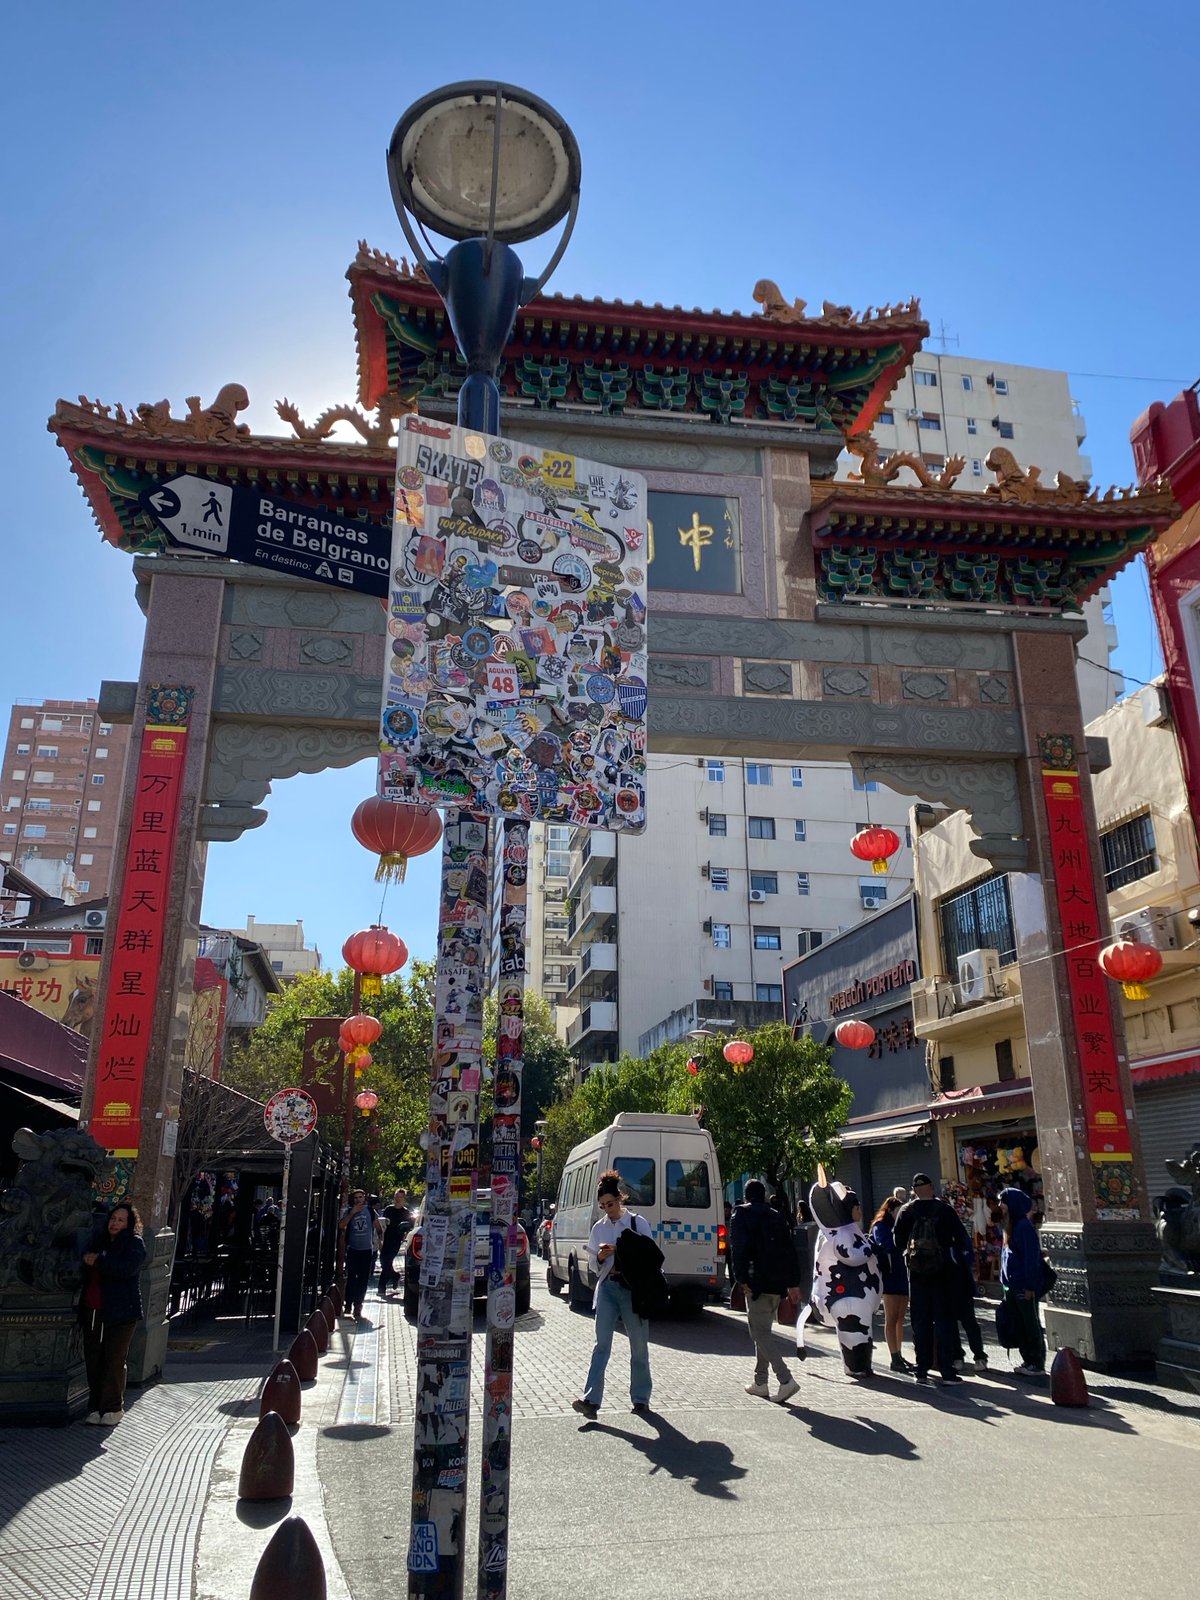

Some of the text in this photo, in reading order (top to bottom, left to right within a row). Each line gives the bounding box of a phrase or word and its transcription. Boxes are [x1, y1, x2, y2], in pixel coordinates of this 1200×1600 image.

[544, 460, 572, 478] +22
[259, 499, 369, 544] Barrancas
[192, 528, 222, 543] min
[257, 521, 389, 570] de Belgrano
[254, 549, 312, 571] En destino:
[489, 667, 515, 675] AGUANTE
[491, 676, 514, 694] 48
[102, 774, 173, 1082] 万里蓝天群星灿烂
[1055, 813, 1114, 1094] 九州大地百业繁荣
[0, 976, 62, 1003] 成功
